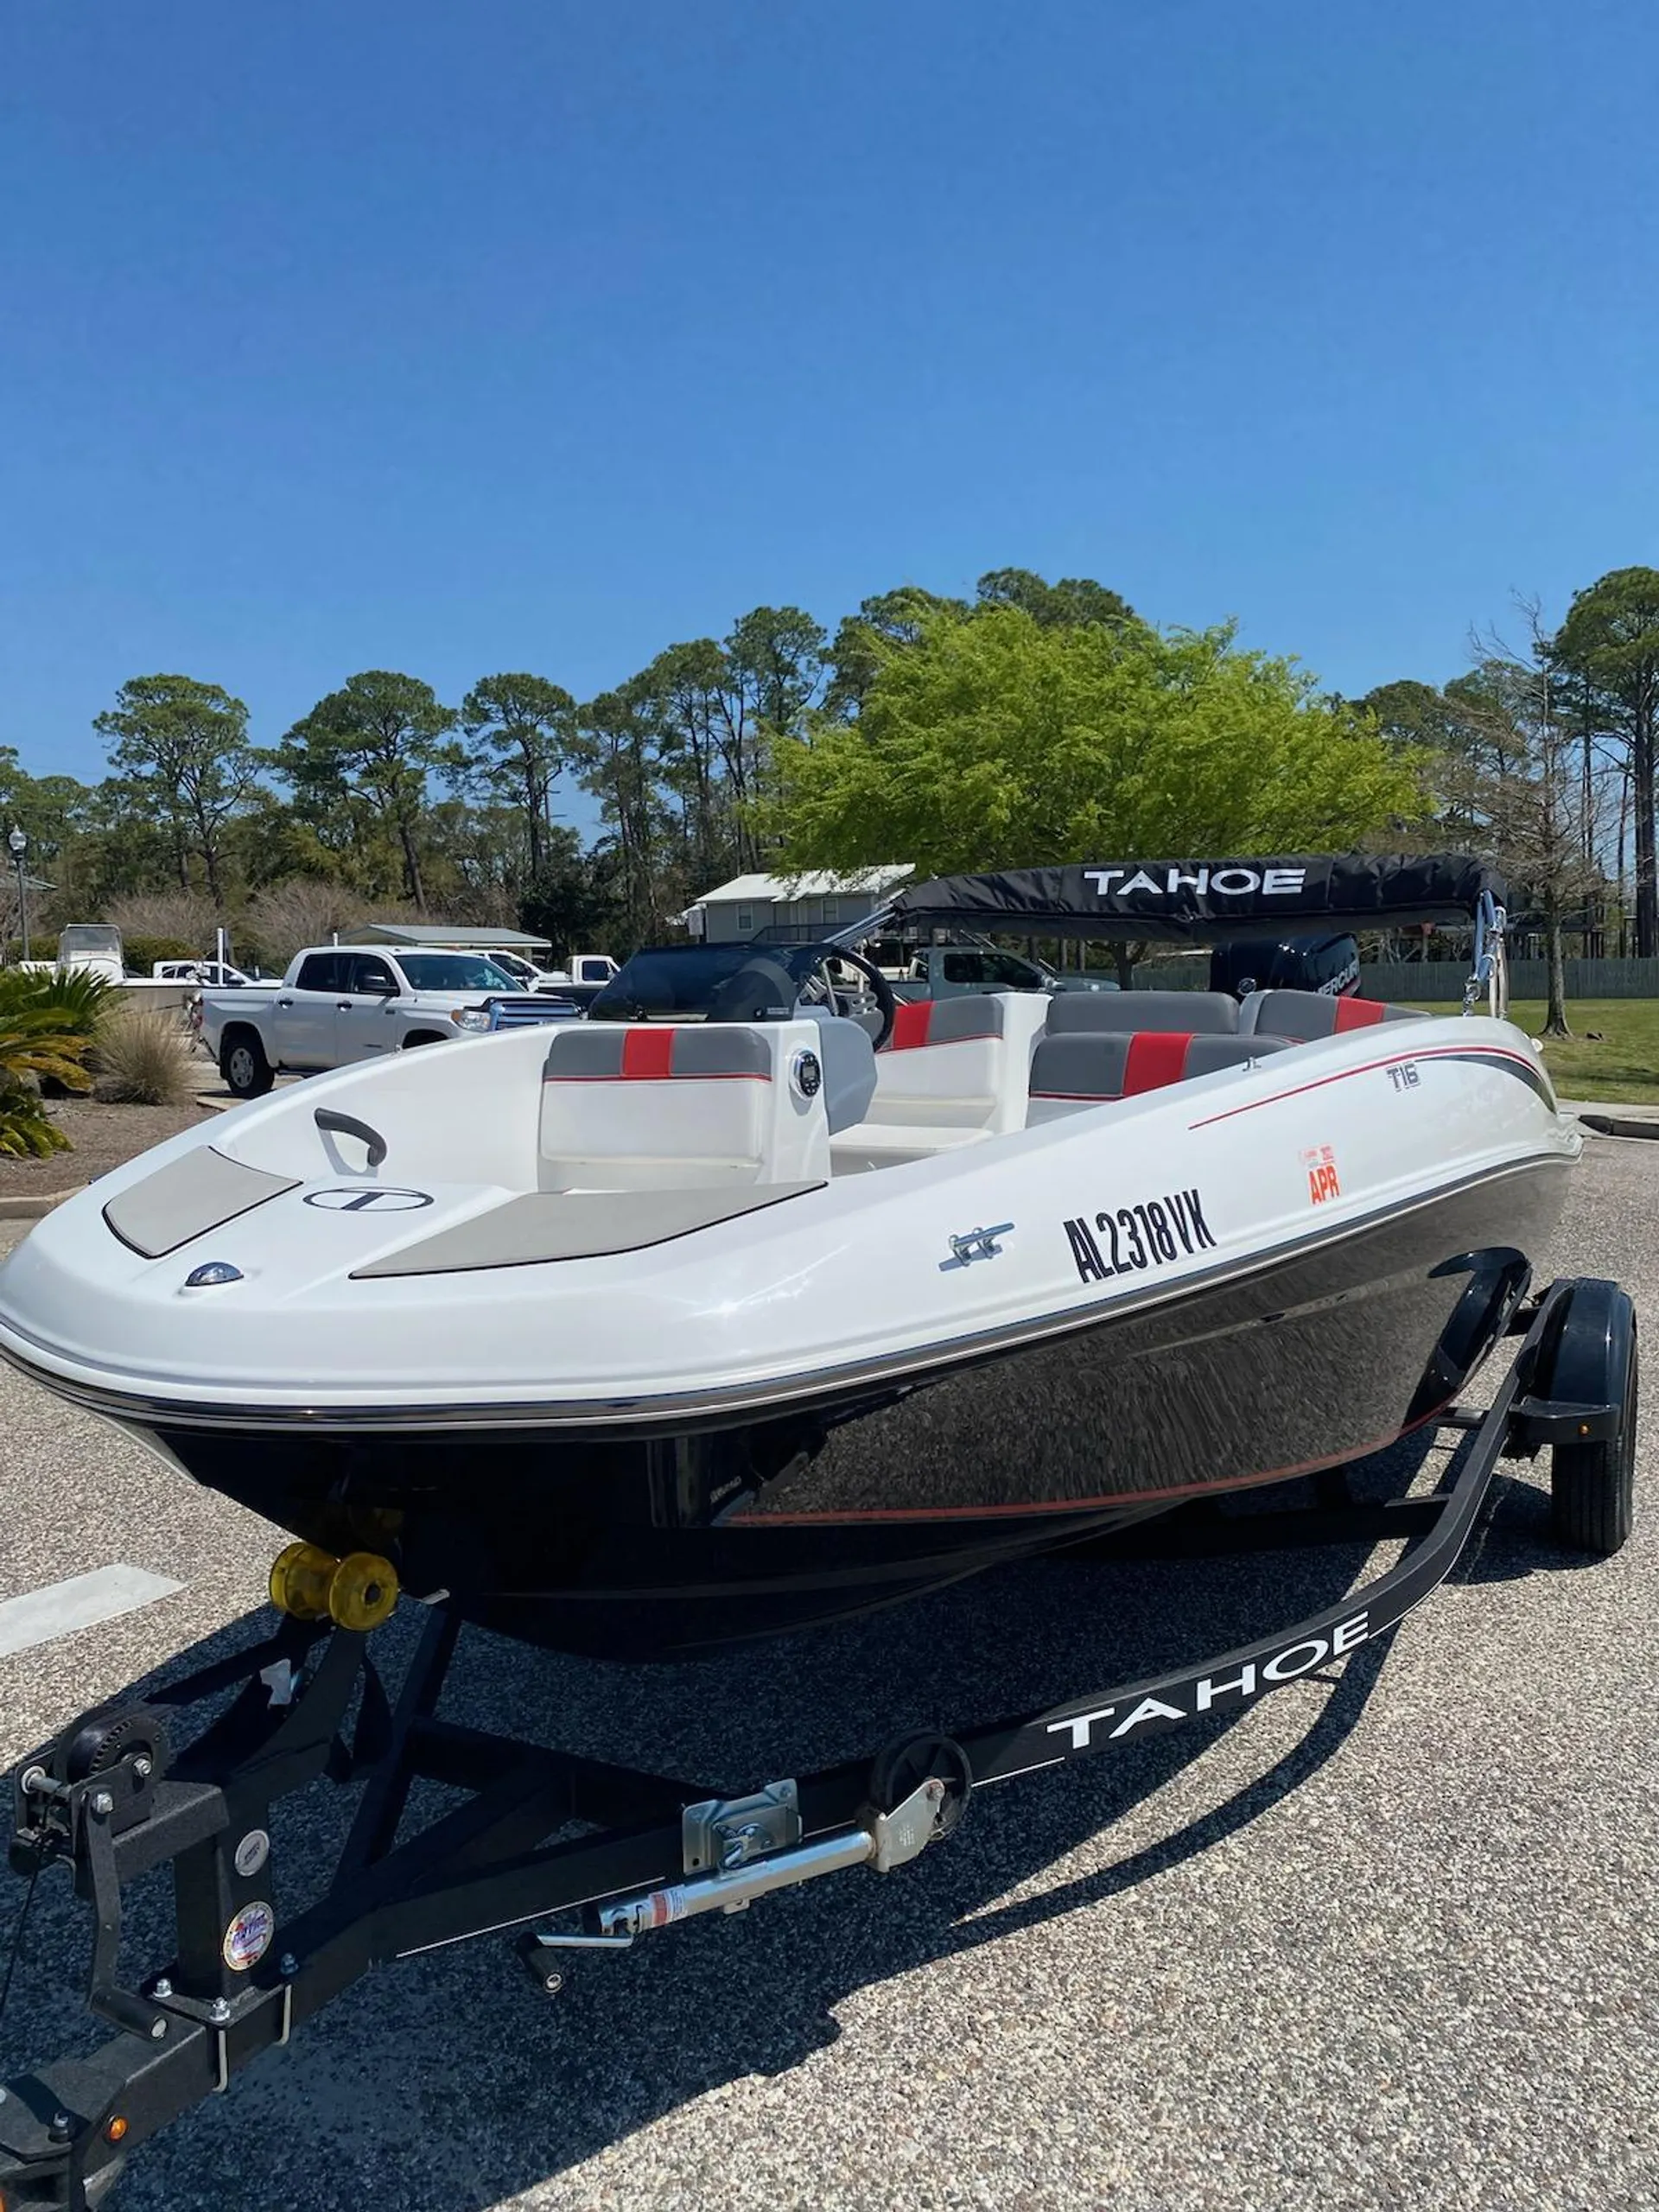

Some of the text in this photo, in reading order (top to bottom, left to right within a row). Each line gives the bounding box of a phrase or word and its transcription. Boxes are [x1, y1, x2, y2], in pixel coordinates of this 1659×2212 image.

[1084, 868, 1306, 895] TAHOE
[1387, 1063, 1419, 1090] T16
[1309, 1165, 1340, 1205] APR
[1047, 1612, 1369, 1749] TAHOE
